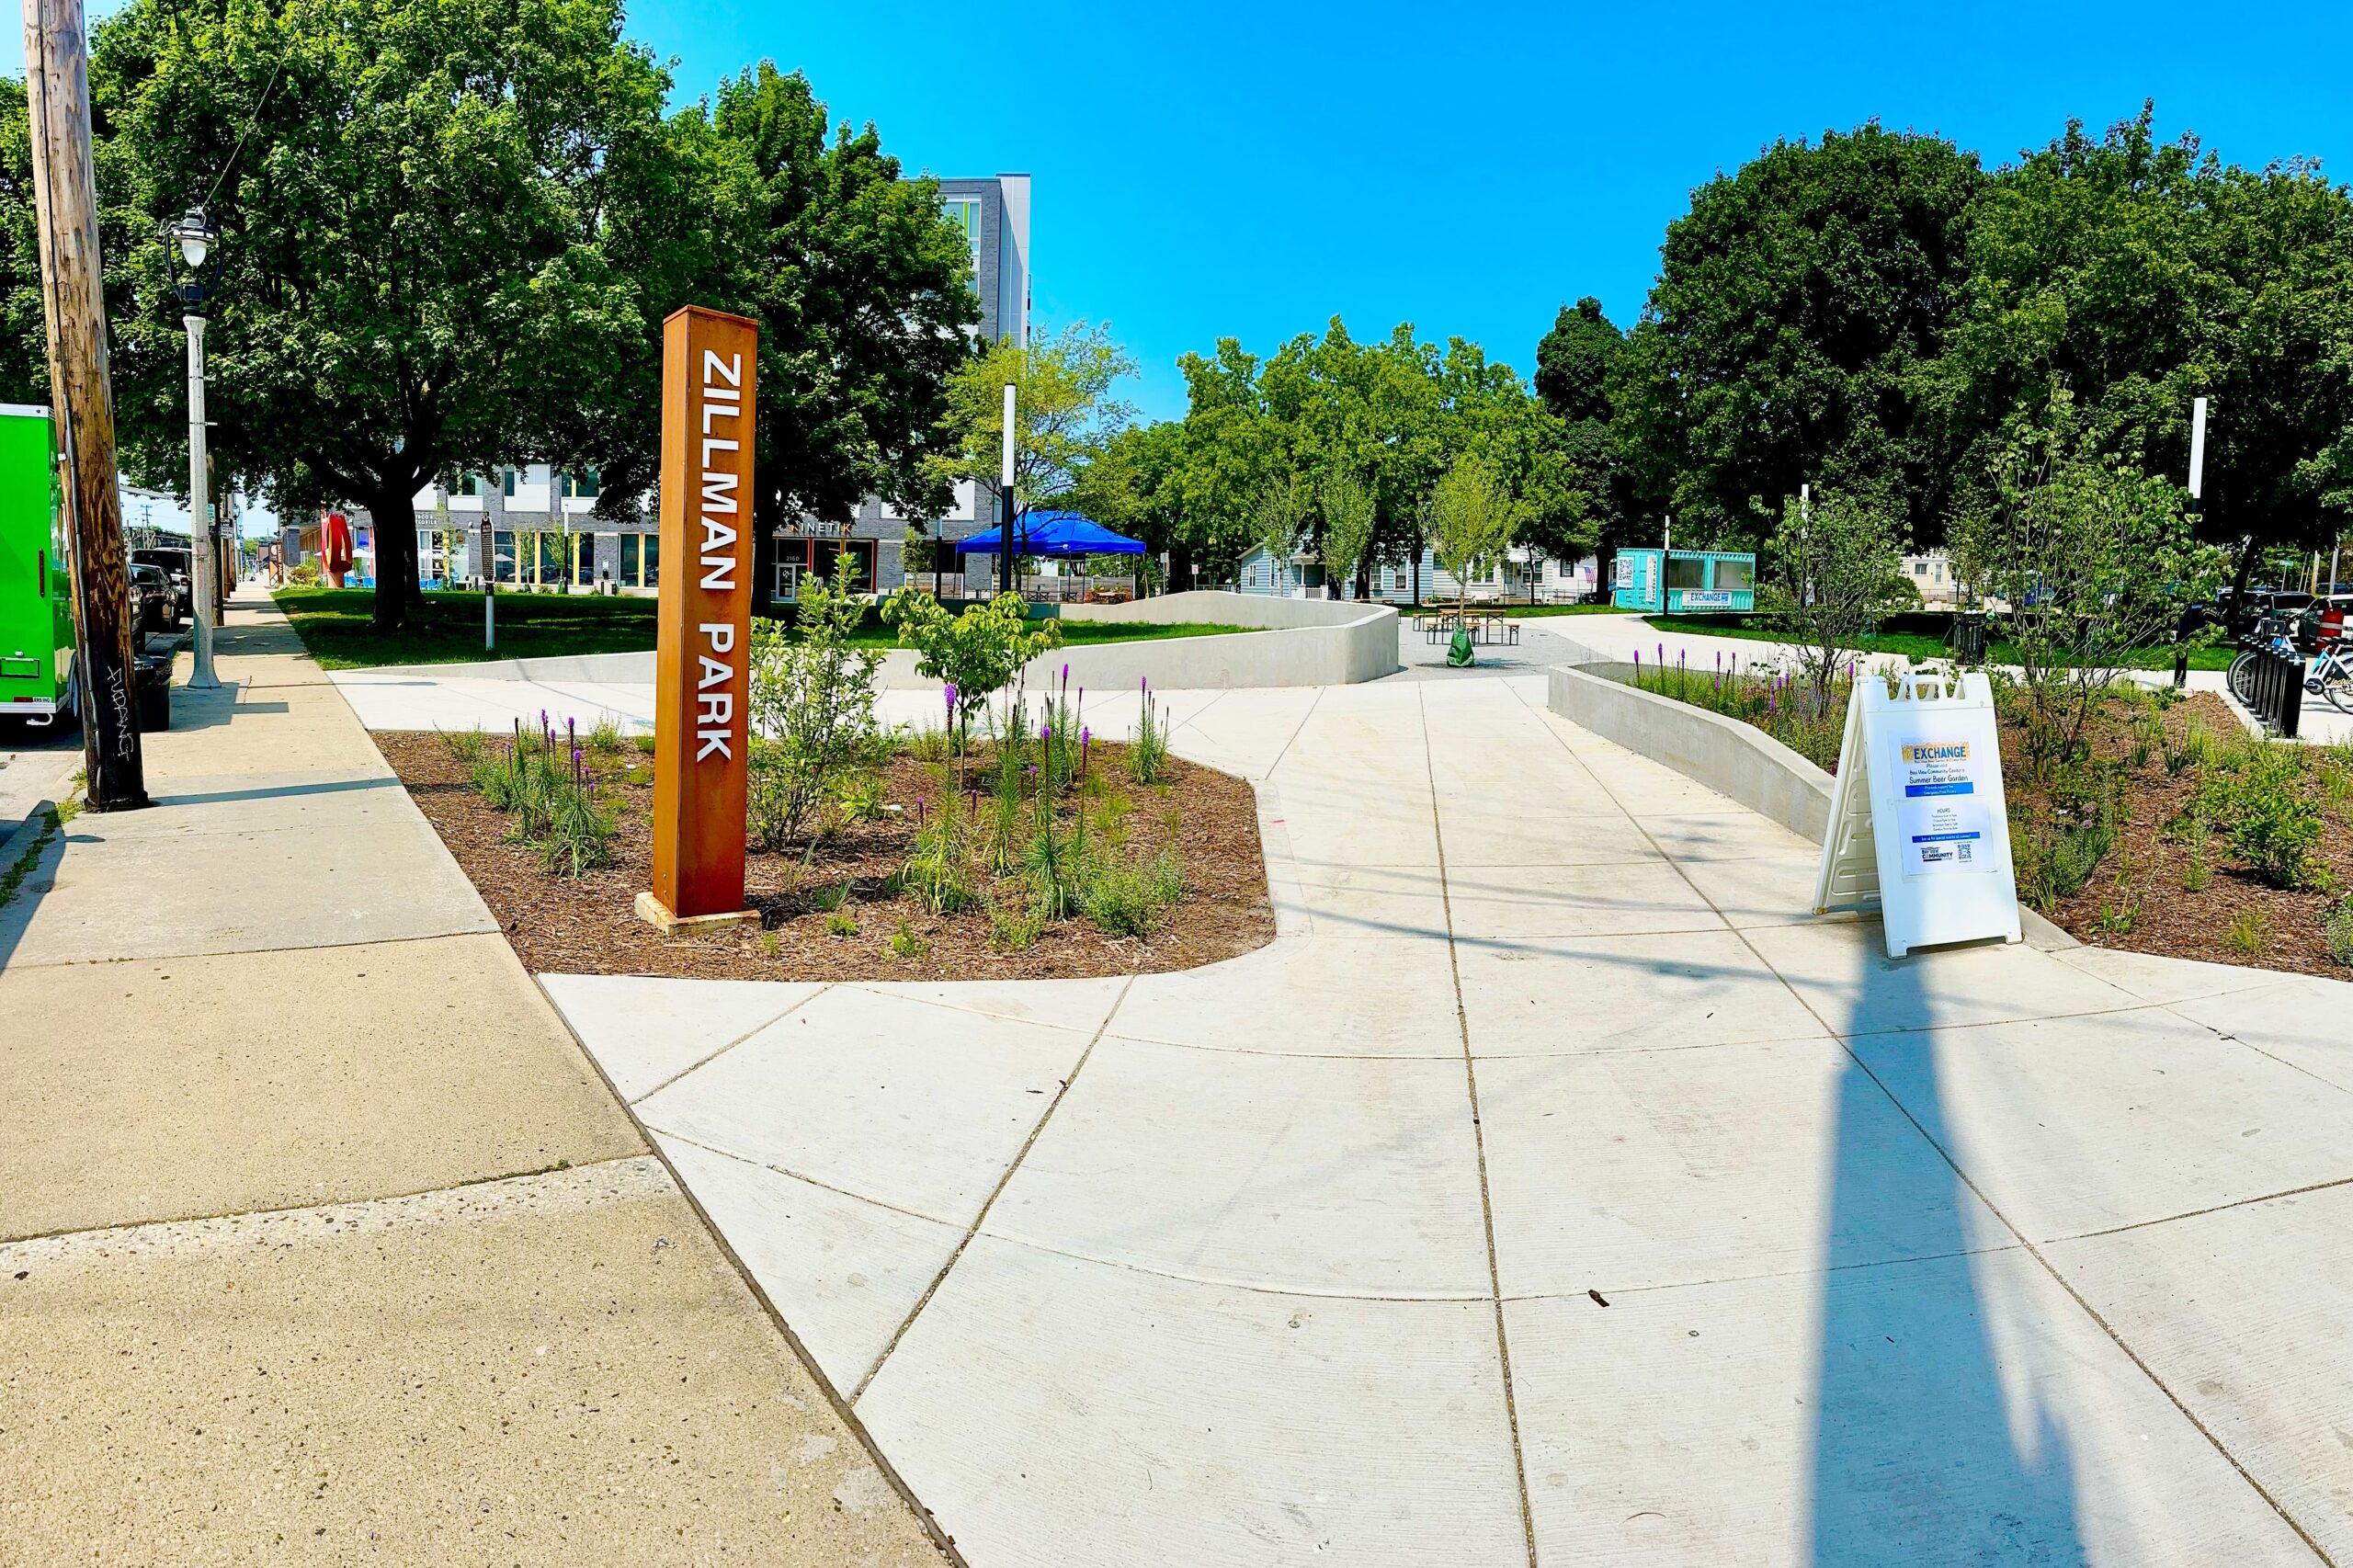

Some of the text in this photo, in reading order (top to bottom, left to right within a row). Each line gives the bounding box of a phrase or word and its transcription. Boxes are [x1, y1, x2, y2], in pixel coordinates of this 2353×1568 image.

[696, 350, 741, 763] ZILLMAN PARK
[1690, 592, 1722, 601] EXCHANGE
[1914, 746, 1967, 760] EXCHANGE
[1909, 777, 1931, 785] Summer
